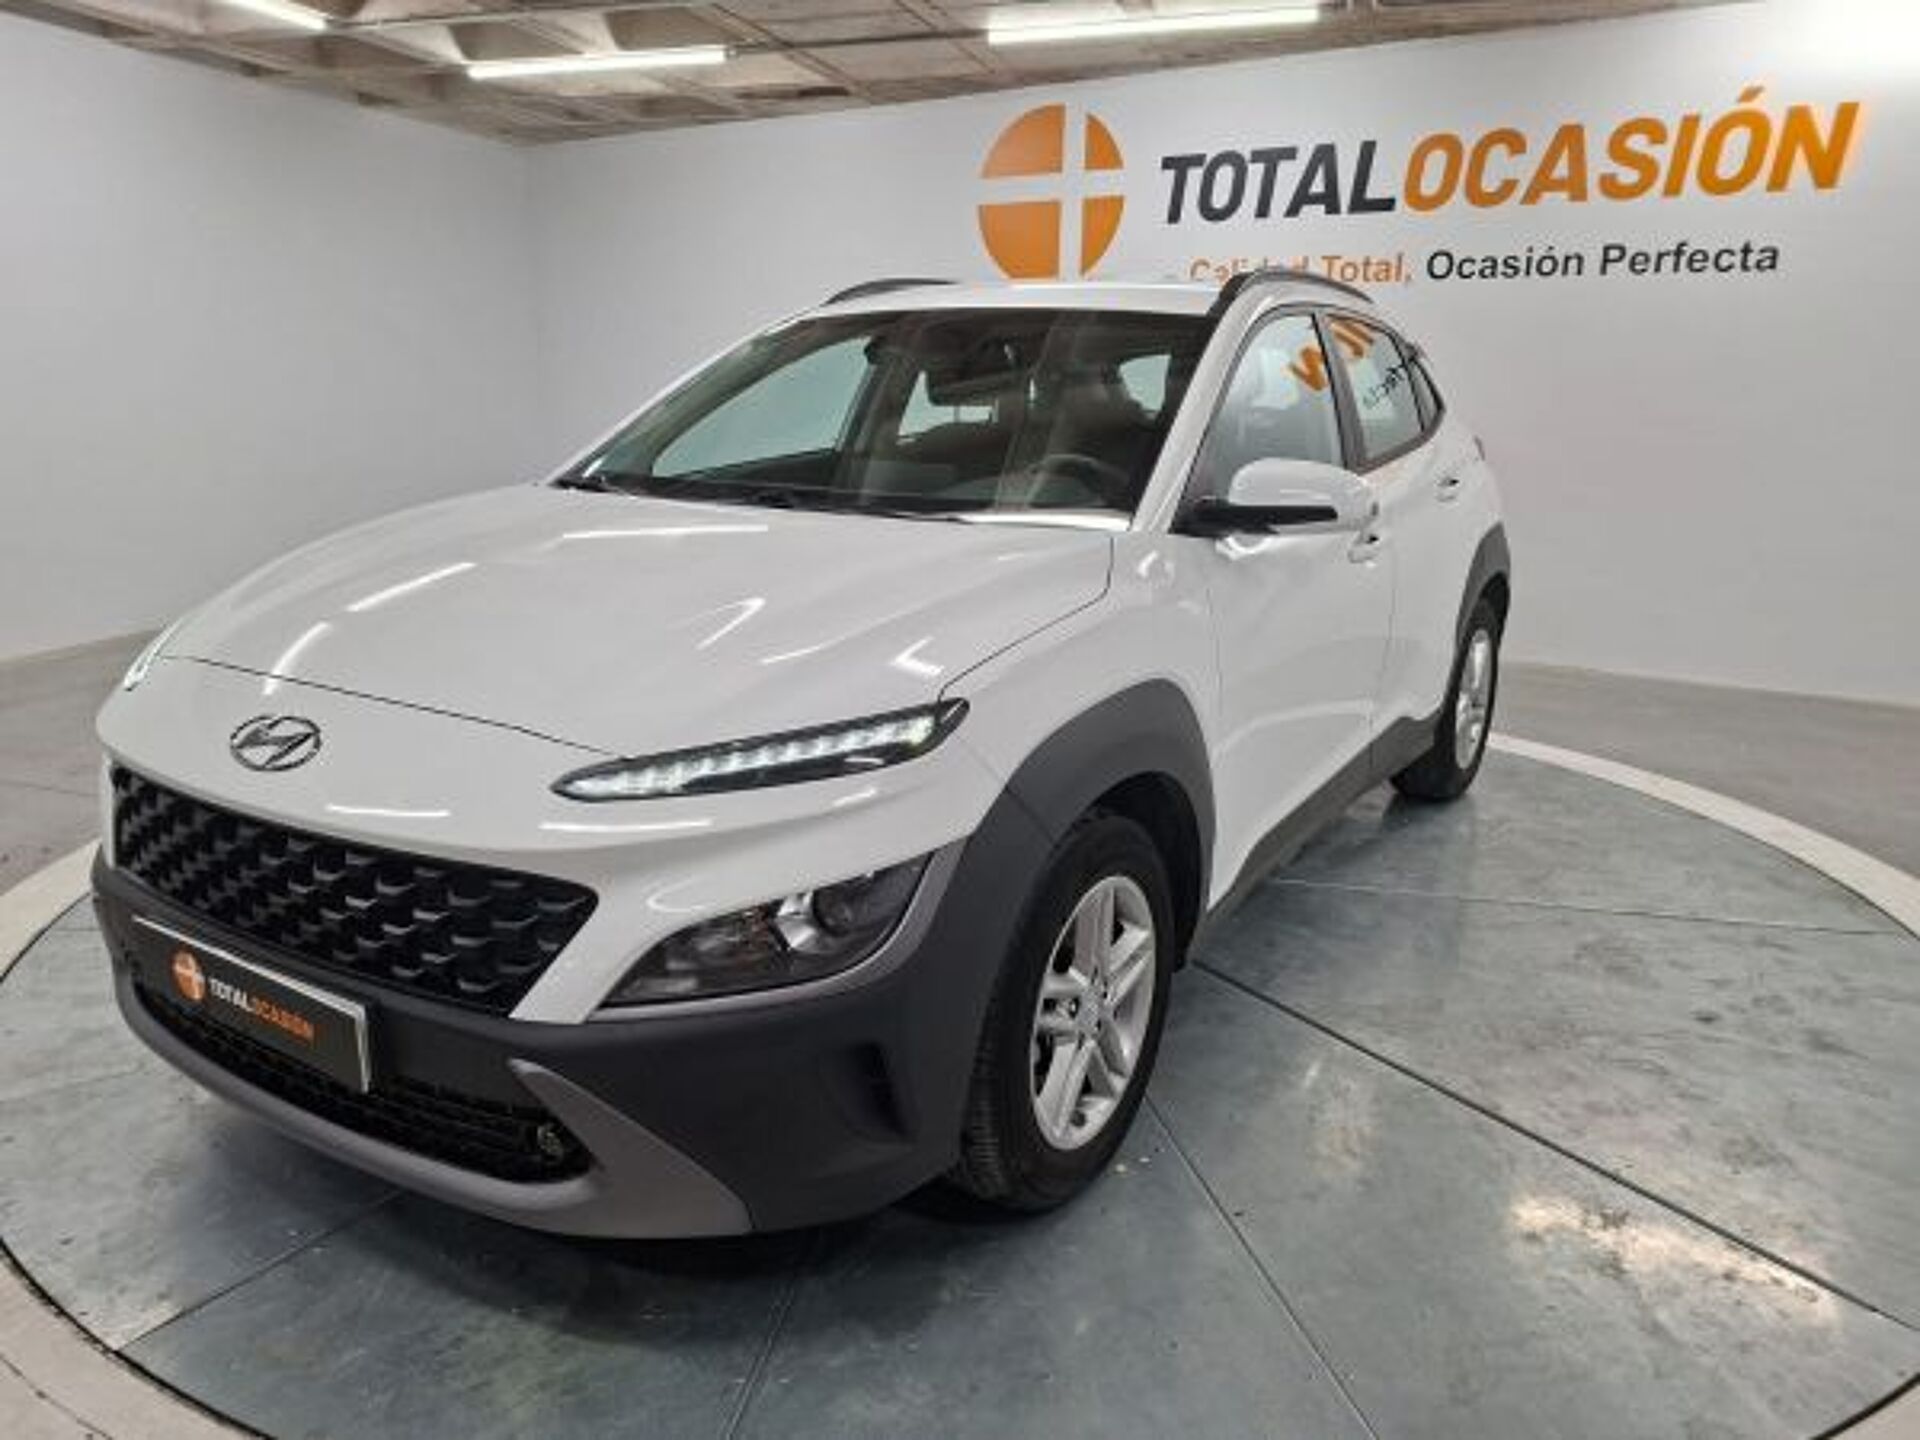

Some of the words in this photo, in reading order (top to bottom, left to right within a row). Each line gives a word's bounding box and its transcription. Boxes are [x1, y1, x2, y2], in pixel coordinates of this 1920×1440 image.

[1321, 253, 1412, 285] Total,
[1426, 246, 1585, 280] Ocasión
[1599, 241, 1780, 276] Perfecta
